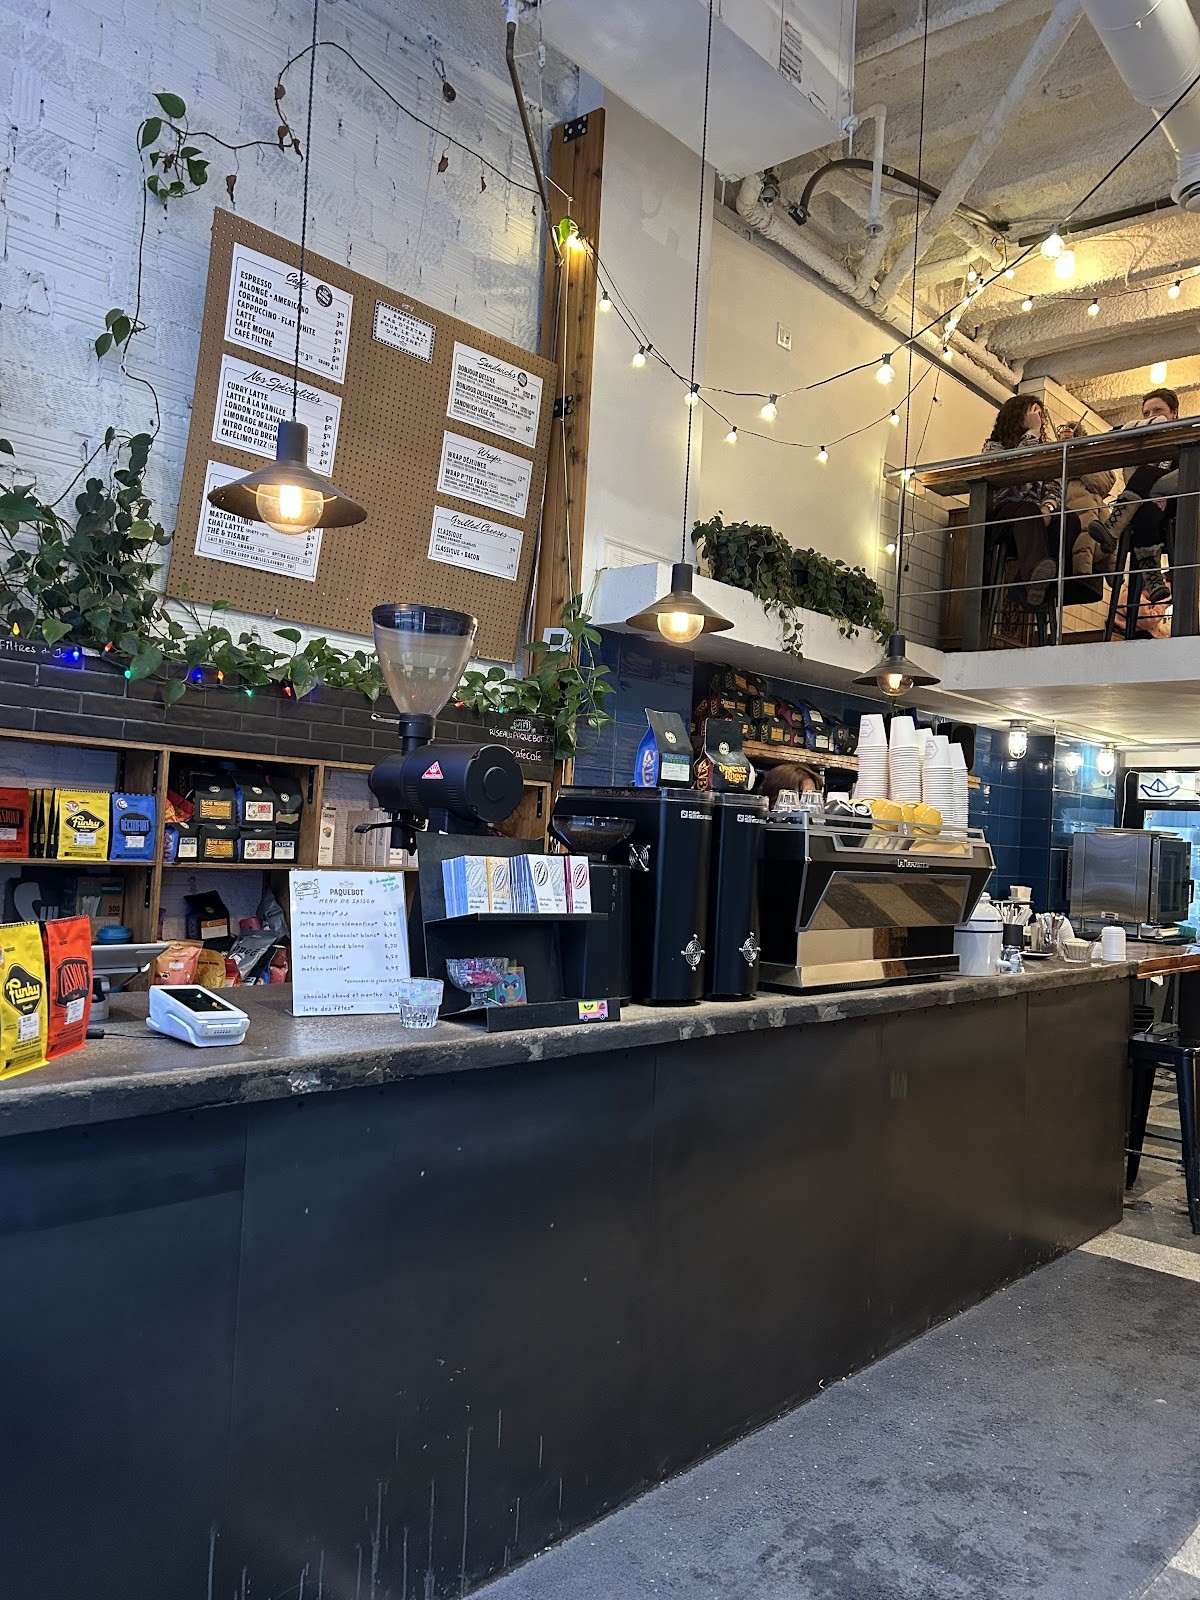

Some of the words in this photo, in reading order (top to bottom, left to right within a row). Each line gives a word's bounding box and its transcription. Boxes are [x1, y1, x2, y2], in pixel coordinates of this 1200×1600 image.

[240, 271, 272, 290] ESPRESSO
[239, 281, 268, 297] ALLONGÉ
[238, 290, 268, 307] CORTADO
[236, 309, 256, 322] LATTE
[238, 300, 277, 320] CAPPUCCINO
[281, 317, 296, 328] FLAT
[384, 316, 396, 324] PAS
[235, 318, 251, 330] CAFÉ
[252, 323, 275, 338] MOCHA
[380, 320, 398, 330] POUR
[413, 335, 428, 343] LAIT
[234, 328, 250, 339] CAFÉ
[251, 333, 272, 348] FILTRE
[244, 371, 267, 384] Nos
[458, 364, 478, 377] BONJOUR
[479, 371, 496, 384] DELUXE
[227, 381, 248, 394] CURRY
[248, 388, 268, 401] LATTE
[456, 381, 476, 394] BONJOUR
[494, 395, 508, 406] BACON
[225, 400, 252, 414] LONDON
[252, 408, 265, 419] FOG
[226, 390, 246, 403] LATTE
[252, 398, 261, 408] LA
[261, 402, 286, 416] VANILLE
[454, 398, 477, 411] SANDWICH
[223, 418, 242, 431] NITRO
[244, 426, 259, 436] COLD
[224, 409, 257, 425] LIMONADE
[258, 420, 278, 432] MAISO
[221, 428, 252, 444] CAFÉLIMO
[253, 438, 268, 448] FIZZ
[447, 451, 462, 460] WRAP
[445, 468, 460, 478] WRAP
[208, 518, 224, 529] CHAÏ
[224, 523, 244, 532] LATTE
[209, 510, 236, 522] MATCHA
[237, 517, 254, 526] LIMO
[450, 515, 481, 530] Grilled
[207, 526, 220, 535] THÉ
[226, 532, 249, 542] TISANE
[437, 527, 462, 539] CLASSIQUE
[435, 544, 460, 555] CLASSIQUE
[464, 551, 480, 561] BACON
[513, 732, 544, 743] PAQUEBOT
[725, 770, 747, 783] Roger
[72, 815, 100, 828] Funky
[330, 888, 364, 896] PAQUEBOT
[6, 978, 40, 1004] Funky
